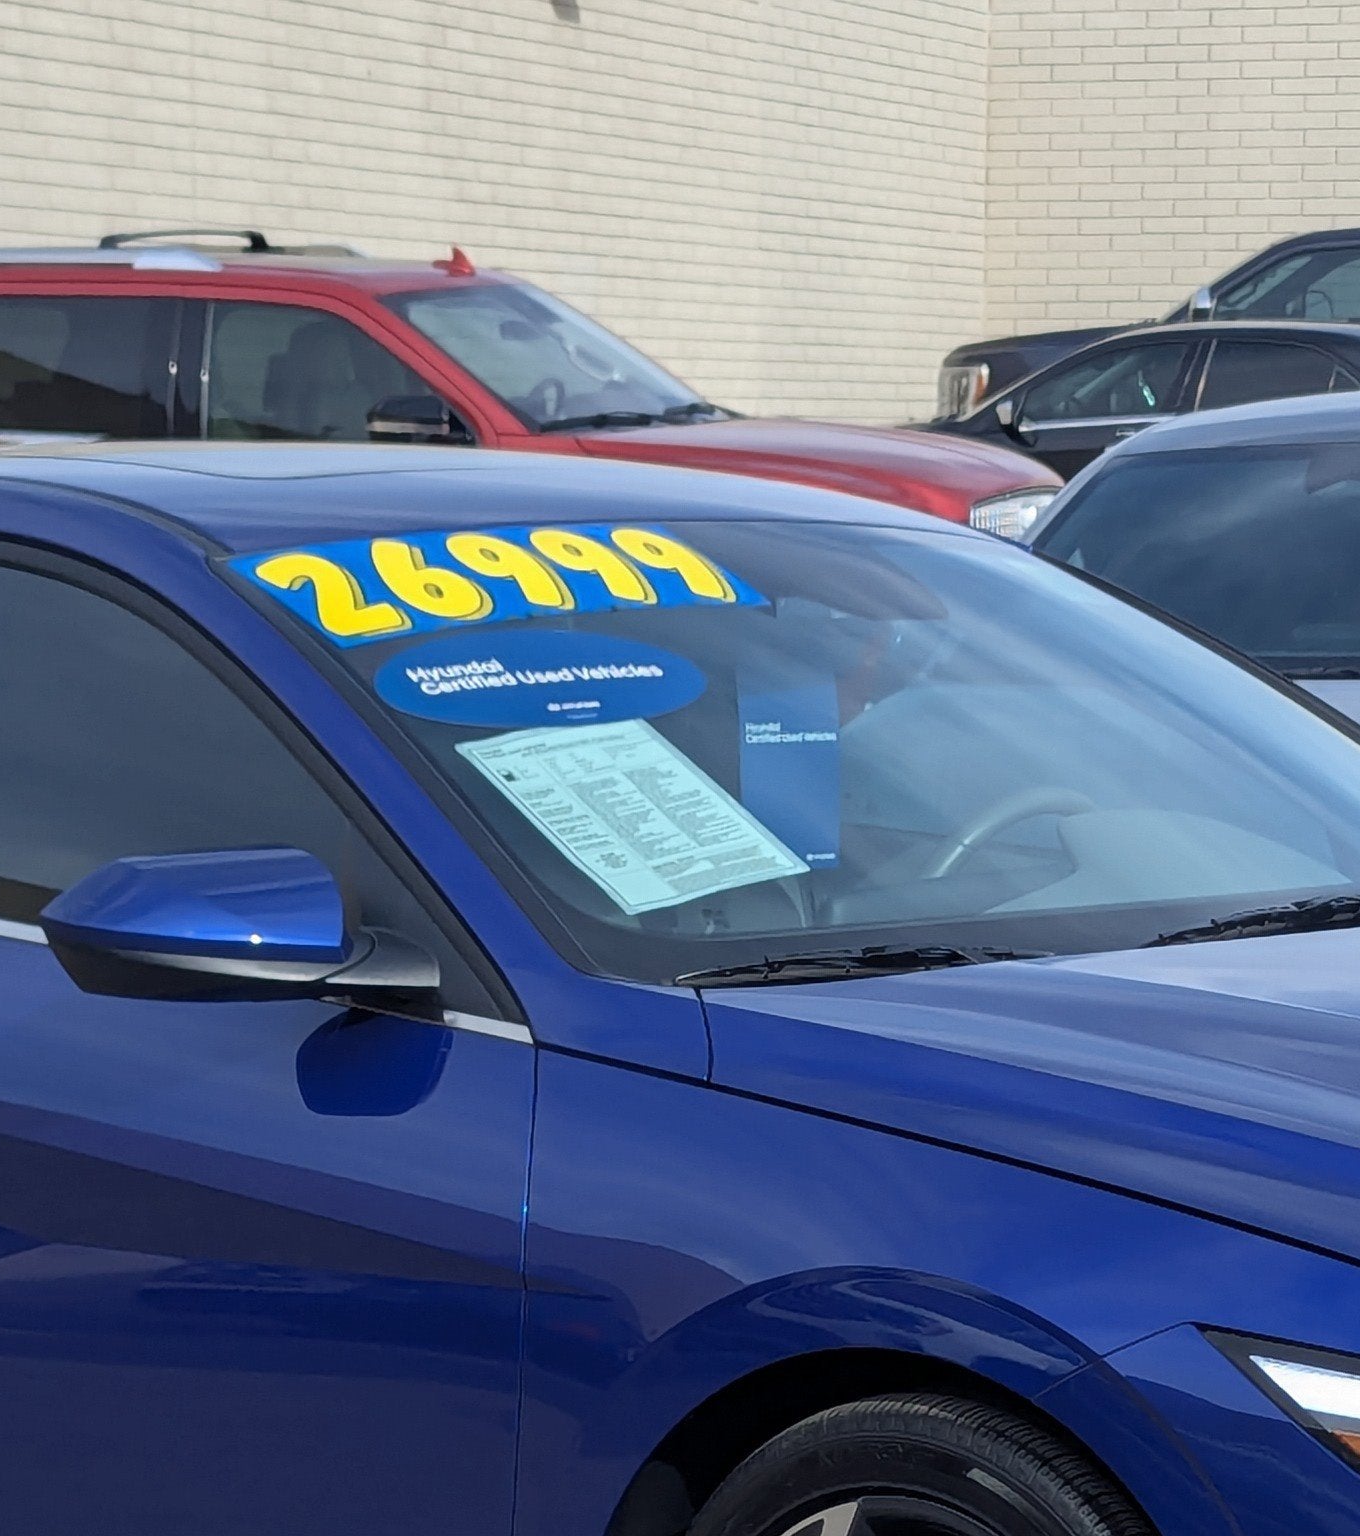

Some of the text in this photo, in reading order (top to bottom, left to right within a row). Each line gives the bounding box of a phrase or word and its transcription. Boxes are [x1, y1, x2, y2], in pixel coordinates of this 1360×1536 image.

[254, 527, 736, 637] 26999
[405, 657, 505, 683] Hyundai
[420, 662, 664, 696] Certified Used Vehicles
